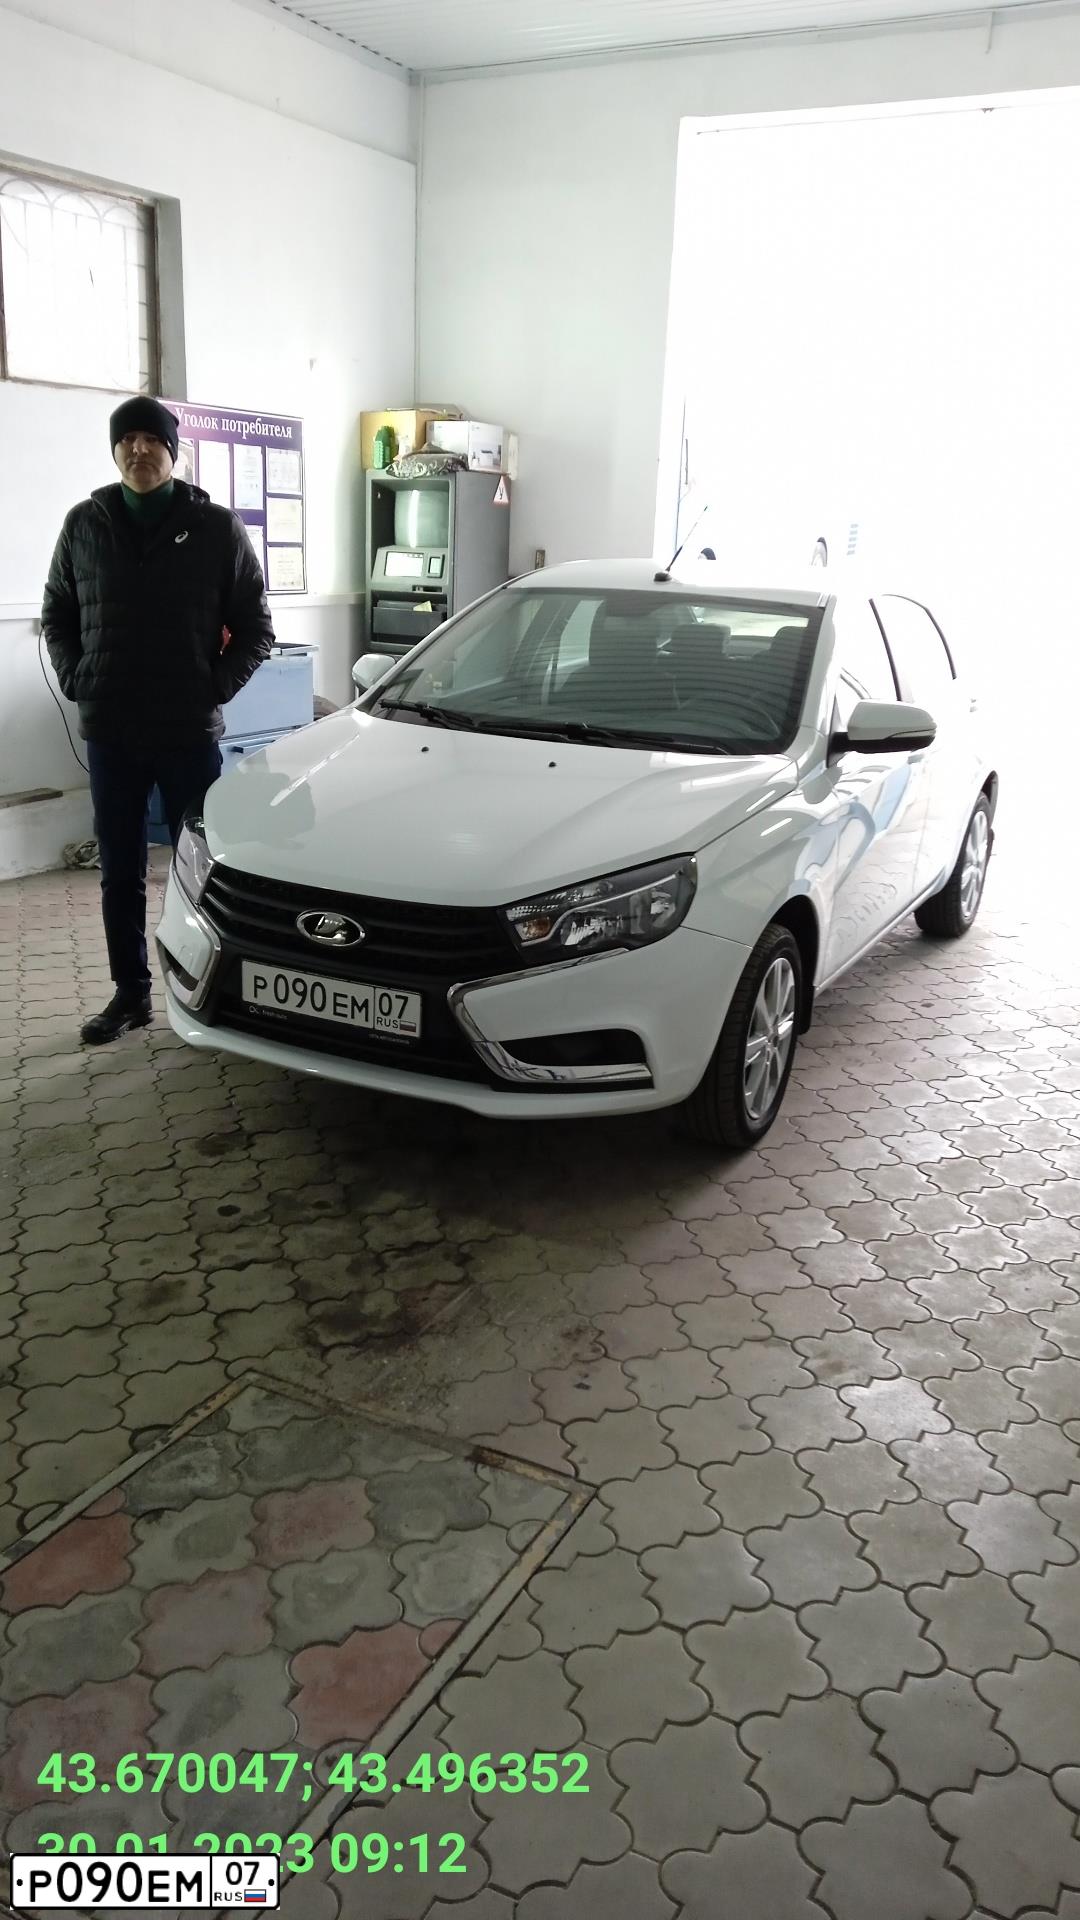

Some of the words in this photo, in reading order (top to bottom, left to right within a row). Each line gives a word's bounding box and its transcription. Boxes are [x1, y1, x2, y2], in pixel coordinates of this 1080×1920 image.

[175, 407, 218, 429] Уголок
[221, 417, 293, 439] потребителя
[253, 973, 369, 1023] Р090ЕМ
[378, 992, 409, 1020] 07
[376, 1016, 399, 1029] RUS
